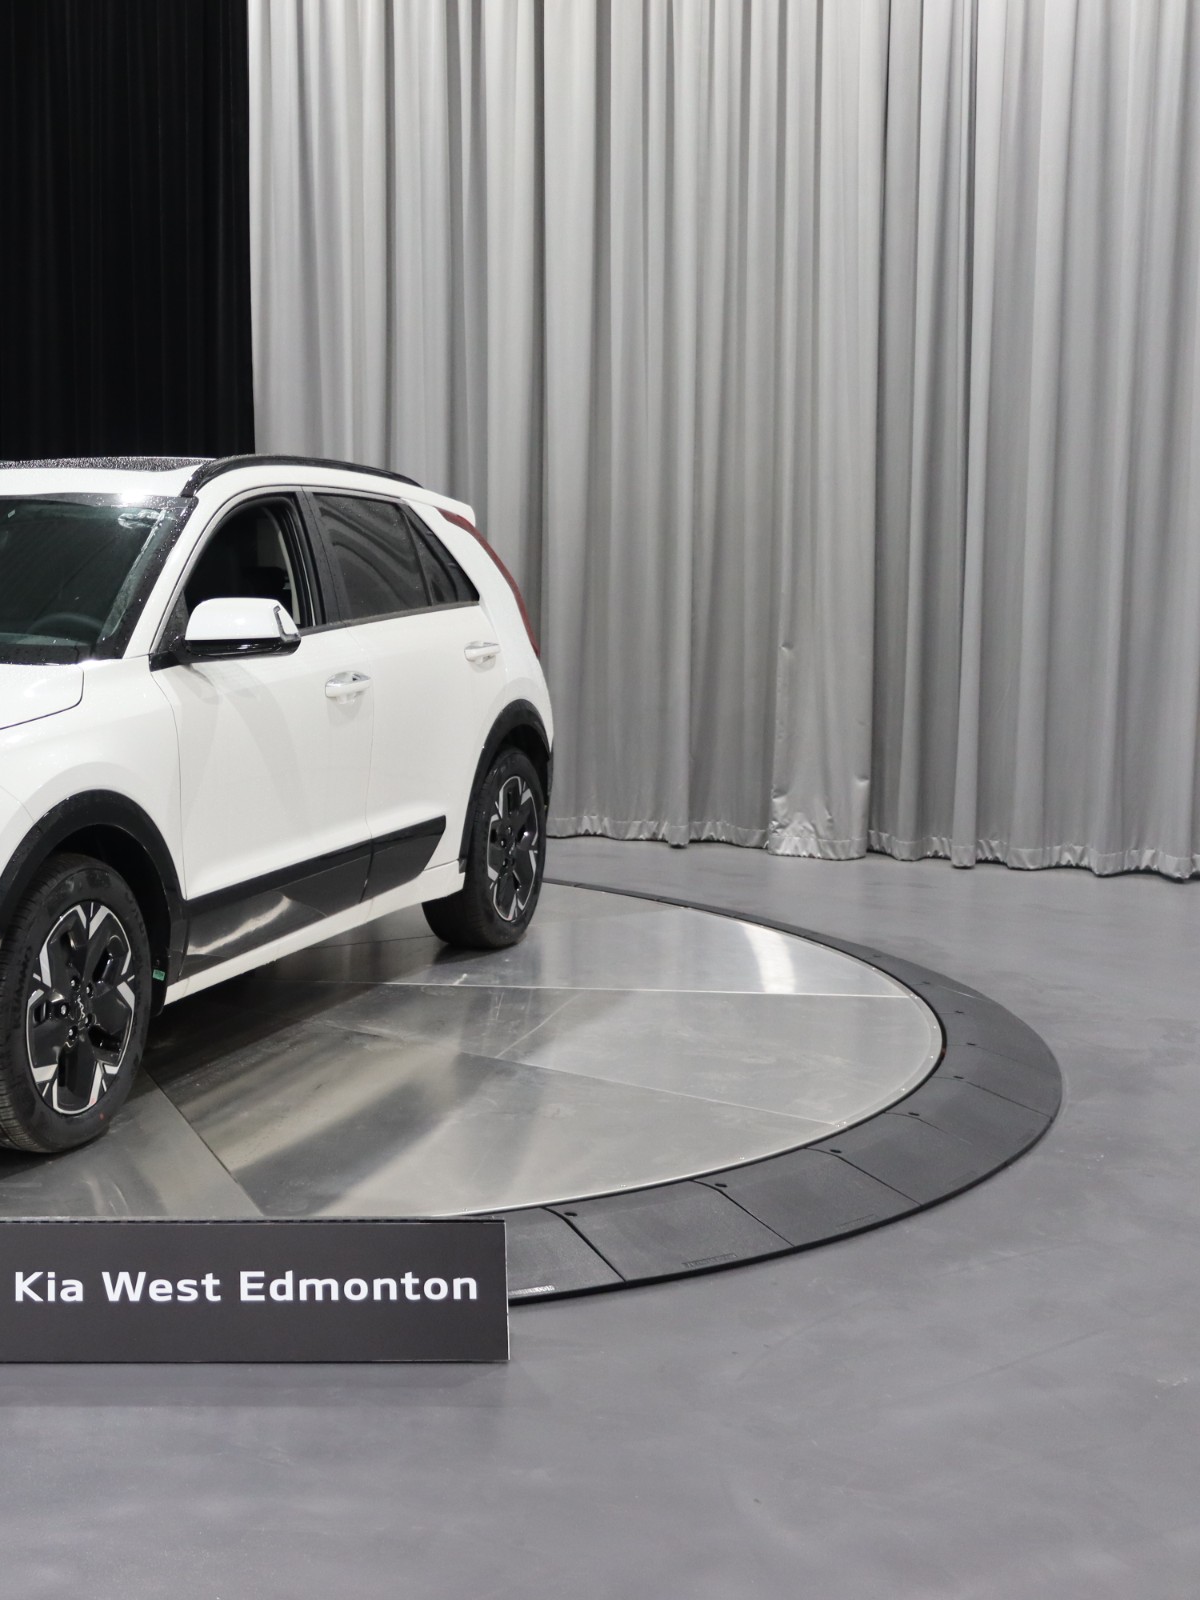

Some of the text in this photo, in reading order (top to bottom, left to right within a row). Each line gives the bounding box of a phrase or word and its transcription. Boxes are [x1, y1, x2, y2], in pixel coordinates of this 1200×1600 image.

[14, 1270, 478, 1303] Kia West Edmonton
